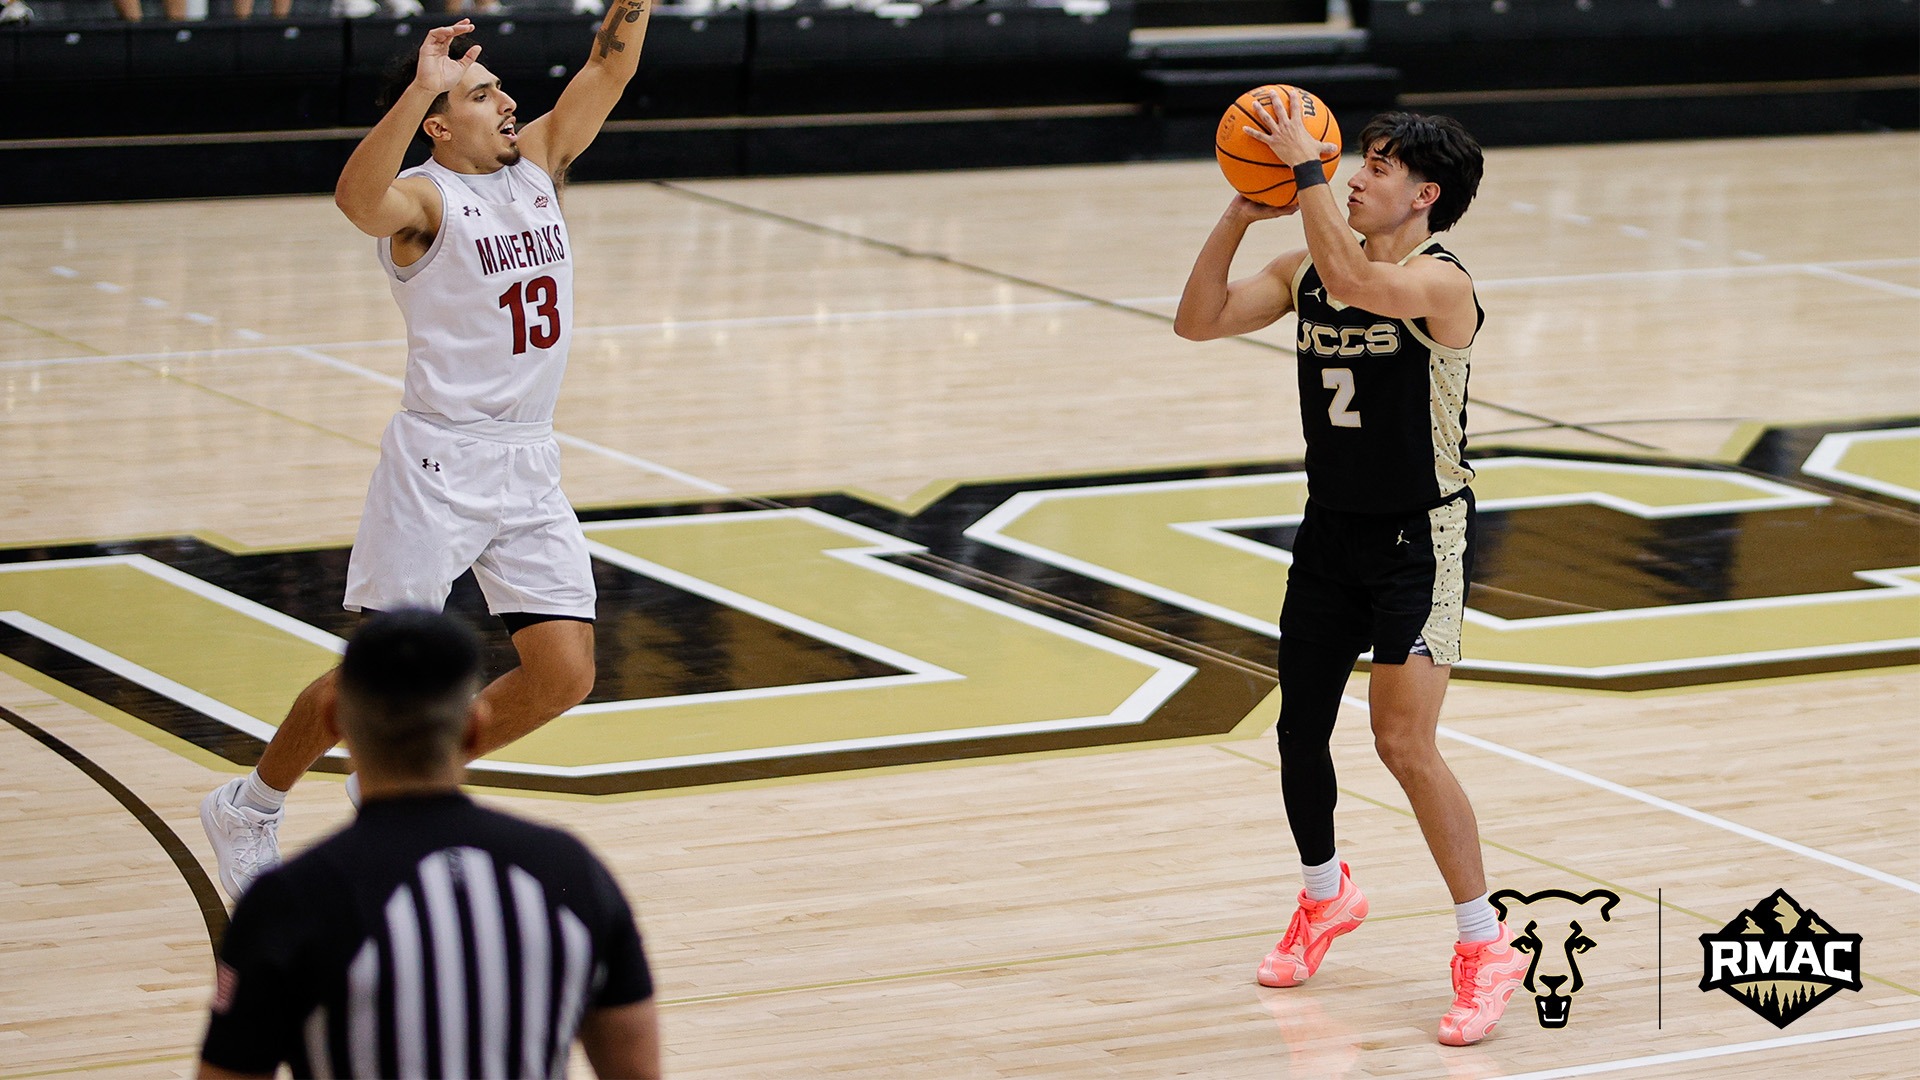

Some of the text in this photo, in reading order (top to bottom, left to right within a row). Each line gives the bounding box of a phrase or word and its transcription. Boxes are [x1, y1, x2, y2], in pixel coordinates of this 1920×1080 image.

[475, 224, 565, 276] MAVERICKS
[499, 275, 561, 355] 13
[1321, 368, 1362, 428] 2
